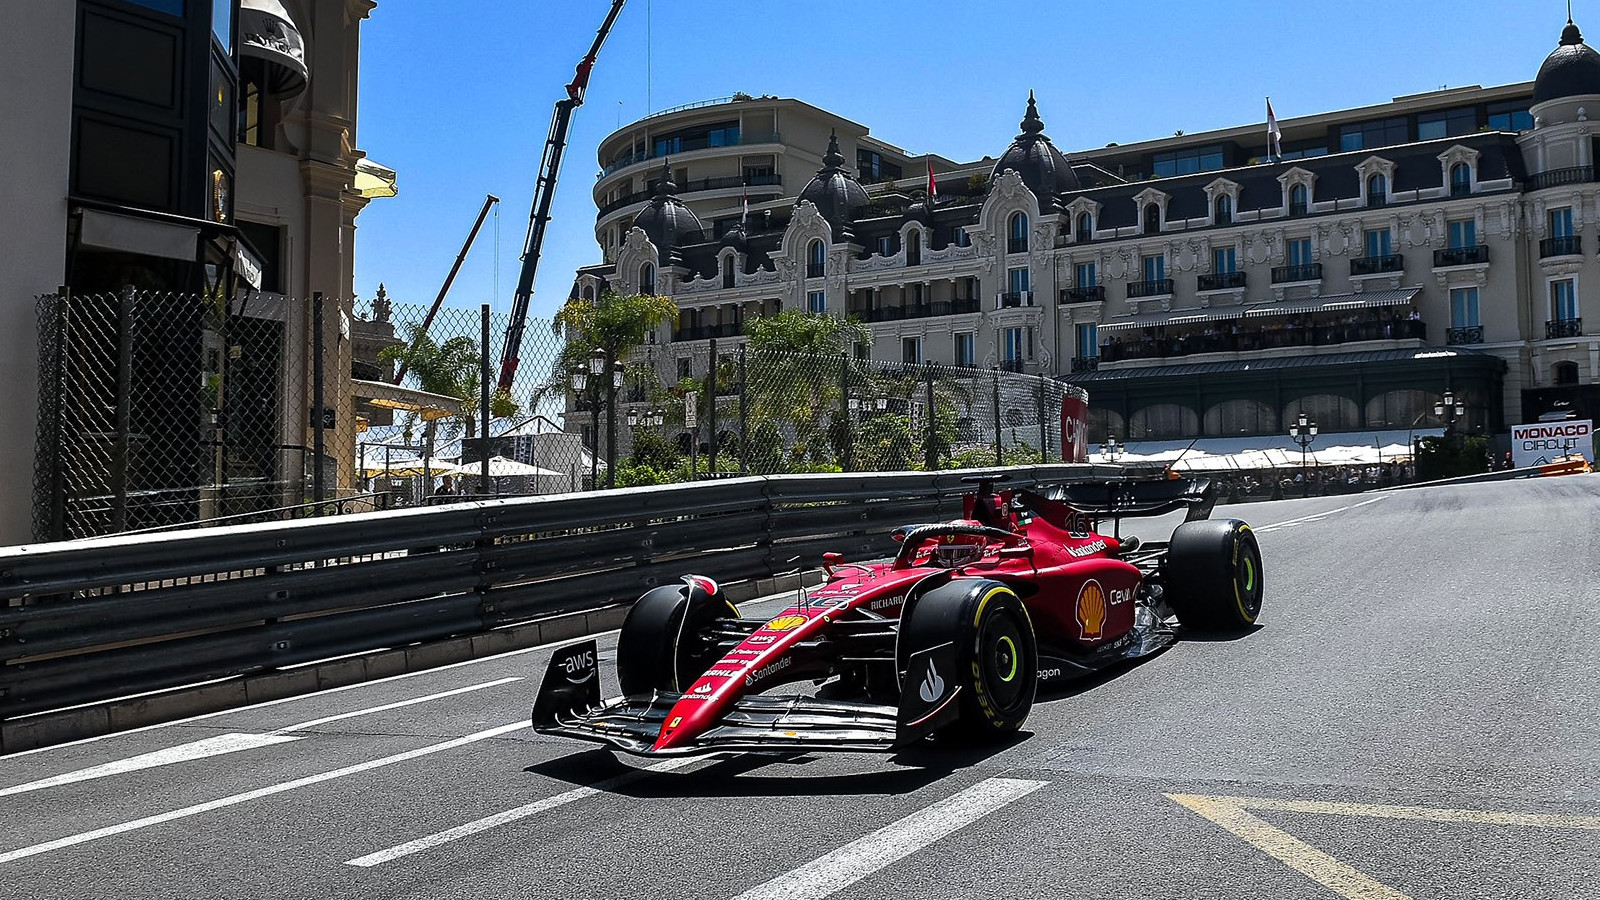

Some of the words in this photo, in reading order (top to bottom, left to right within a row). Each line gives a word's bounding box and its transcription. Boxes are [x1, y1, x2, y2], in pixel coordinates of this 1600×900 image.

[1514, 425, 1588, 440] MONACO
[1523, 438, 1579, 451] CIRCUIT
[1065, 511, 1090, 539] 16
[871, 595, 904, 610] RICHARD
[565, 650, 595, 674] aws
[752, 656, 793, 682] Santander
